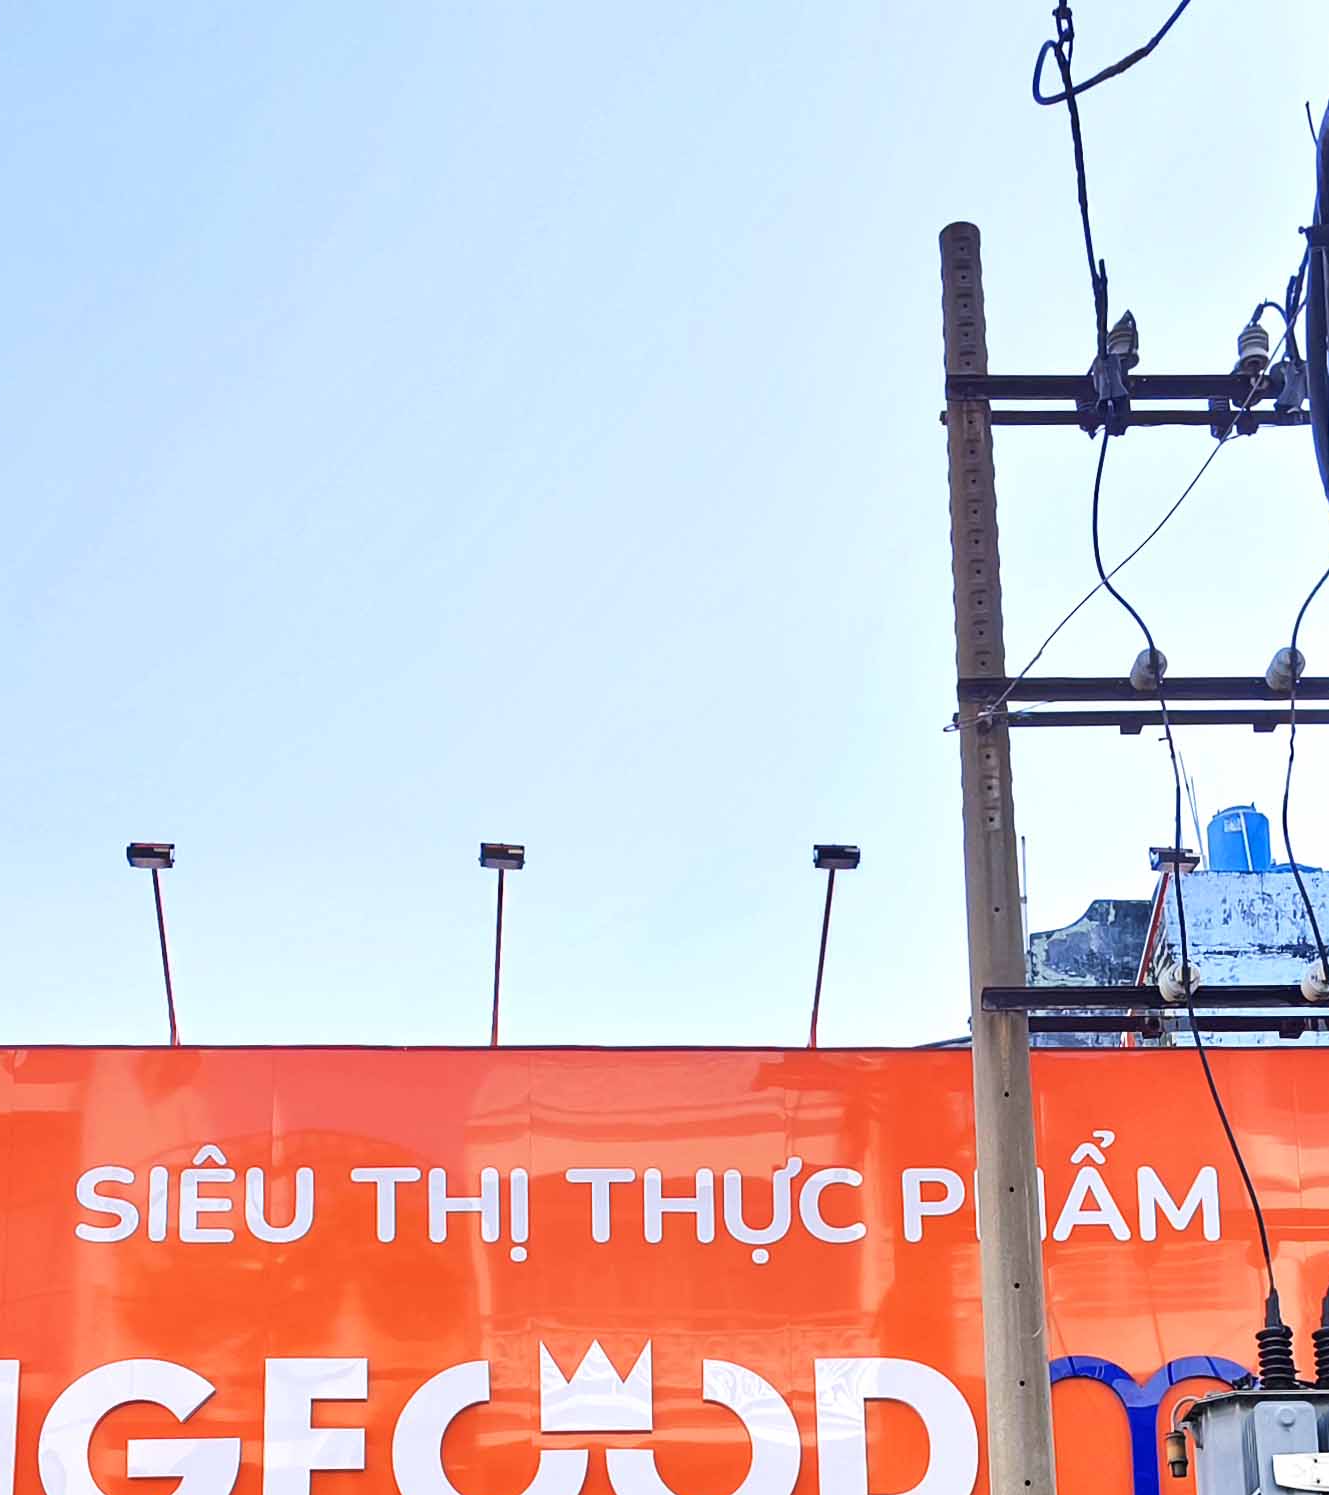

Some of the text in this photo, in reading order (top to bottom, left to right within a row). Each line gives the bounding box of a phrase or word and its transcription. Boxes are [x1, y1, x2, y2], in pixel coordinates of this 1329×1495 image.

[74, 1143, 315, 1244] SIÊU
[352, 1166, 529, 1264] THỊ
[567, 1156, 867, 1264] THỰC
